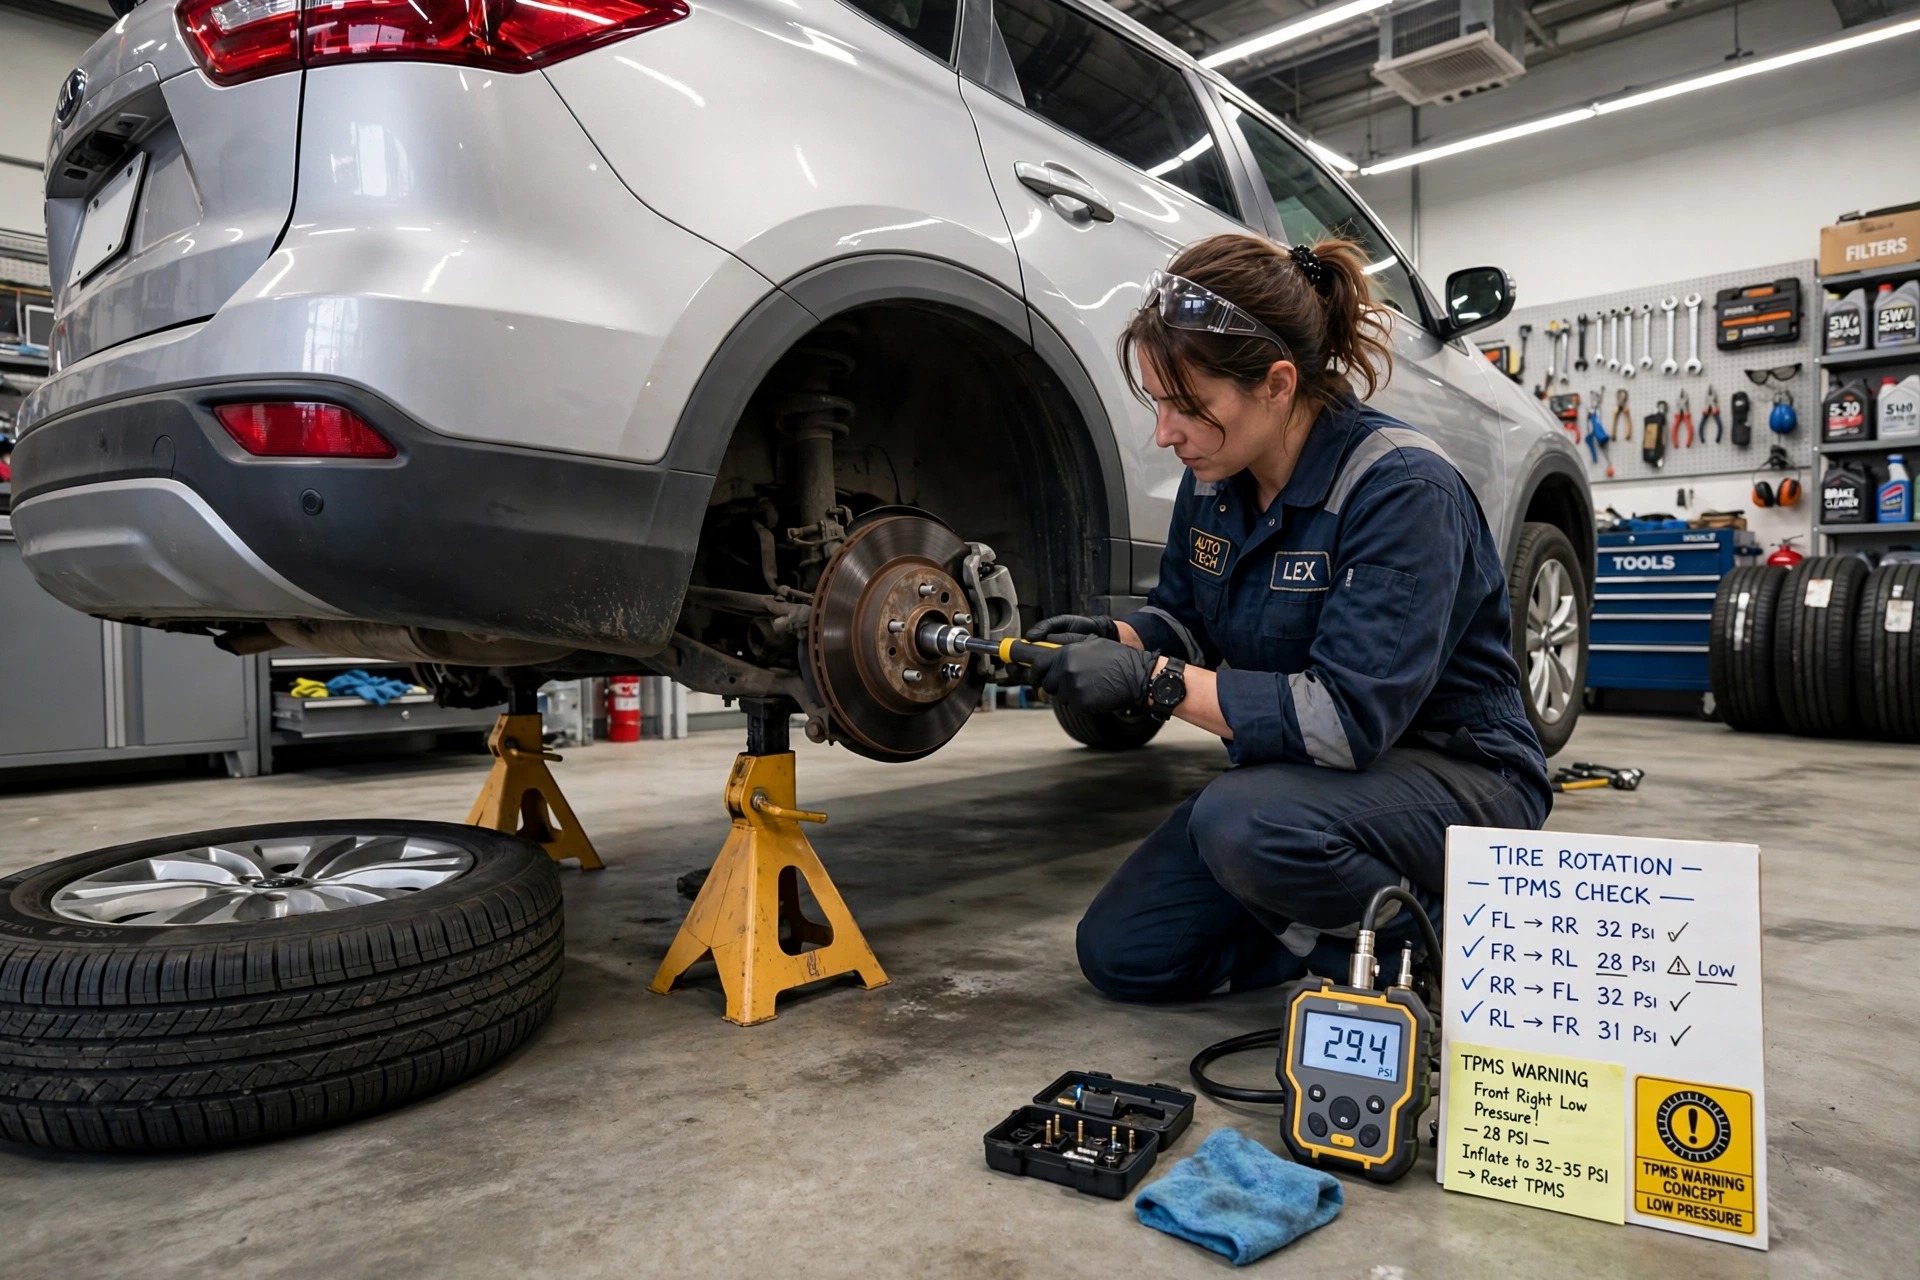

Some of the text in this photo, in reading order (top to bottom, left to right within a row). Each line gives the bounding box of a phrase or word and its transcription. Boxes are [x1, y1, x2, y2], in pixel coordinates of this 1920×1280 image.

[1845, 237, 1908, 262] FILTERS
[1194, 536, 1221, 556] AUTO
[1194, 549, 1219, 569] TECH
[1282, 561, 1316, 581] LEX
[1612, 555, 1675, 571] TOOLS
[1488, 846, 1672, 877] TIRE ROTATION
[1497, 877, 1651, 905] TPMS CHECK
[1491, 912, 1516, 930] FL
[1552, 916, 1579, 935] RR
[1596, 920, 1623, 938] 32
[1491, 943, 1517, 963] FR
[1551, 948, 1579, 968] RL
[1597, 953, 1623, 971] 28
[1490, 976, 1517, 996] RR
[1553, 982, 1579, 1002] FL
[1597, 987, 1624, 1006] 32
[1489, 1009, 1515, 1029] RL
[1552, 1016, 1580, 1037] FR
[1598, 1021, 1619, 1041] 31
[1323, 1025, 1388, 1066] 29.4
[1377, 1067, 1393, 1078] PSI
[1460, 1055, 1589, 1088] TPMS WARNING
[1474, 1082, 1588, 1113] Front Right Low
[1475, 1101, 1540, 1126] Pressure!
[1482, 1126, 1528, 1146] 28 PSI
[1462, 1144, 1609, 1184] Inflate to 32-35 PSI
[1644, 1162, 1746, 1192] TPMS WARNING
[1480, 1169, 1565, 1199] Reset TPMS
[1663, 1181, 1725, 1204] CONCEPT
[1647, 1197, 1743, 1227] LOW PRESSURE
